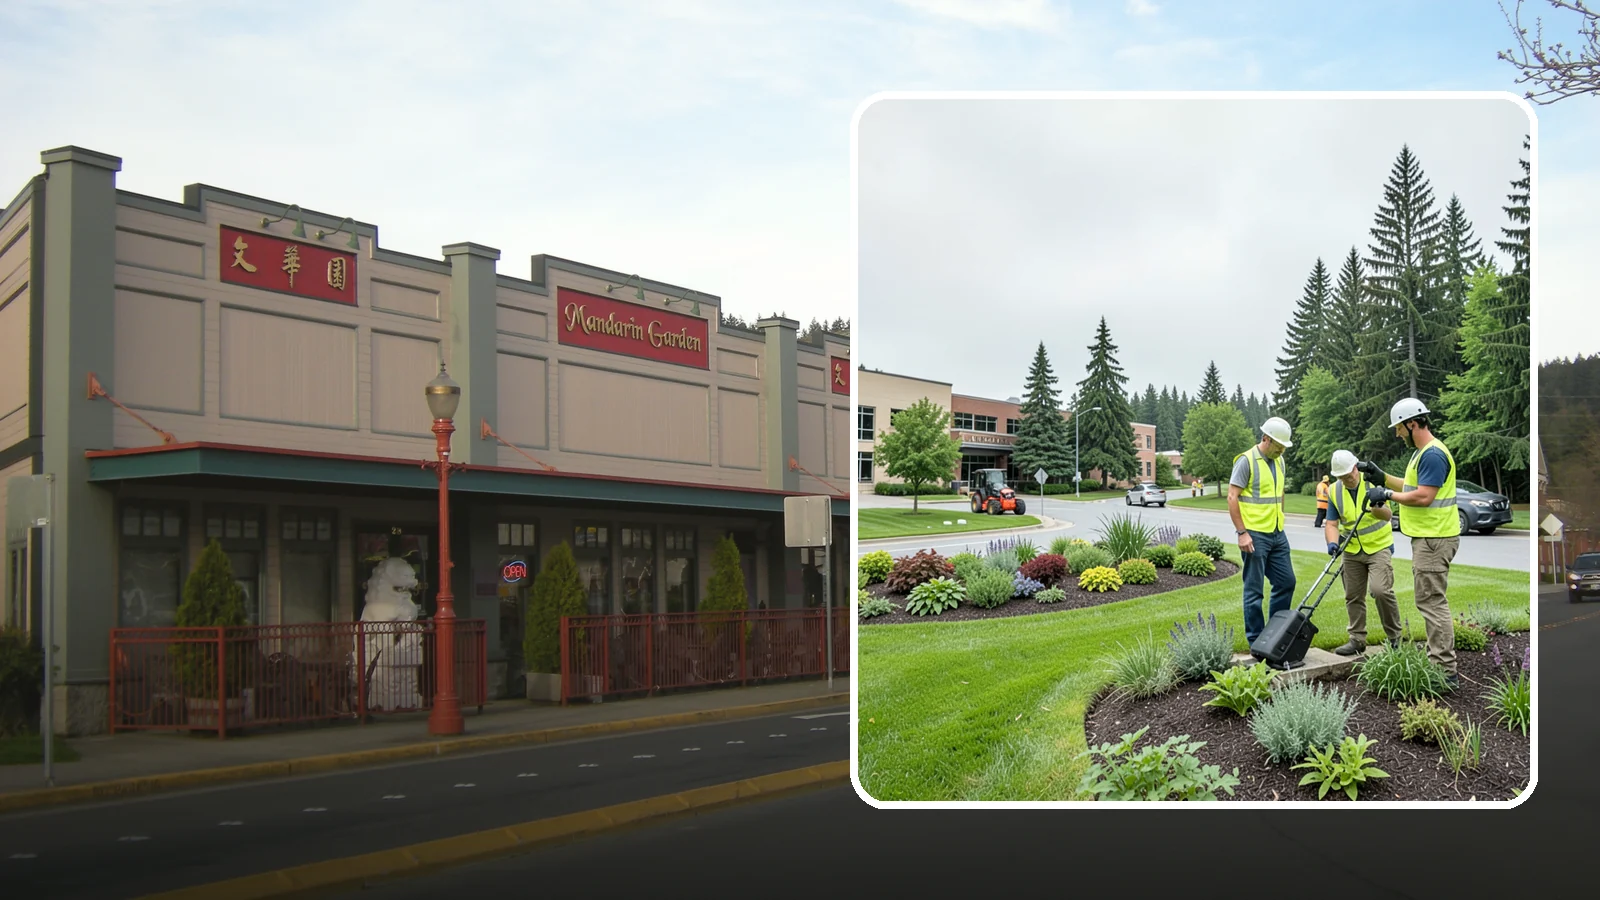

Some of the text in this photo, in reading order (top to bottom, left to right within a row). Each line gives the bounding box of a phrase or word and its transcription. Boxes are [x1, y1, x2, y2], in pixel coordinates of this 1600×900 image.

[564, 302, 701, 352] Mandarin Garden
[503, 565, 526, 578] OPEN
